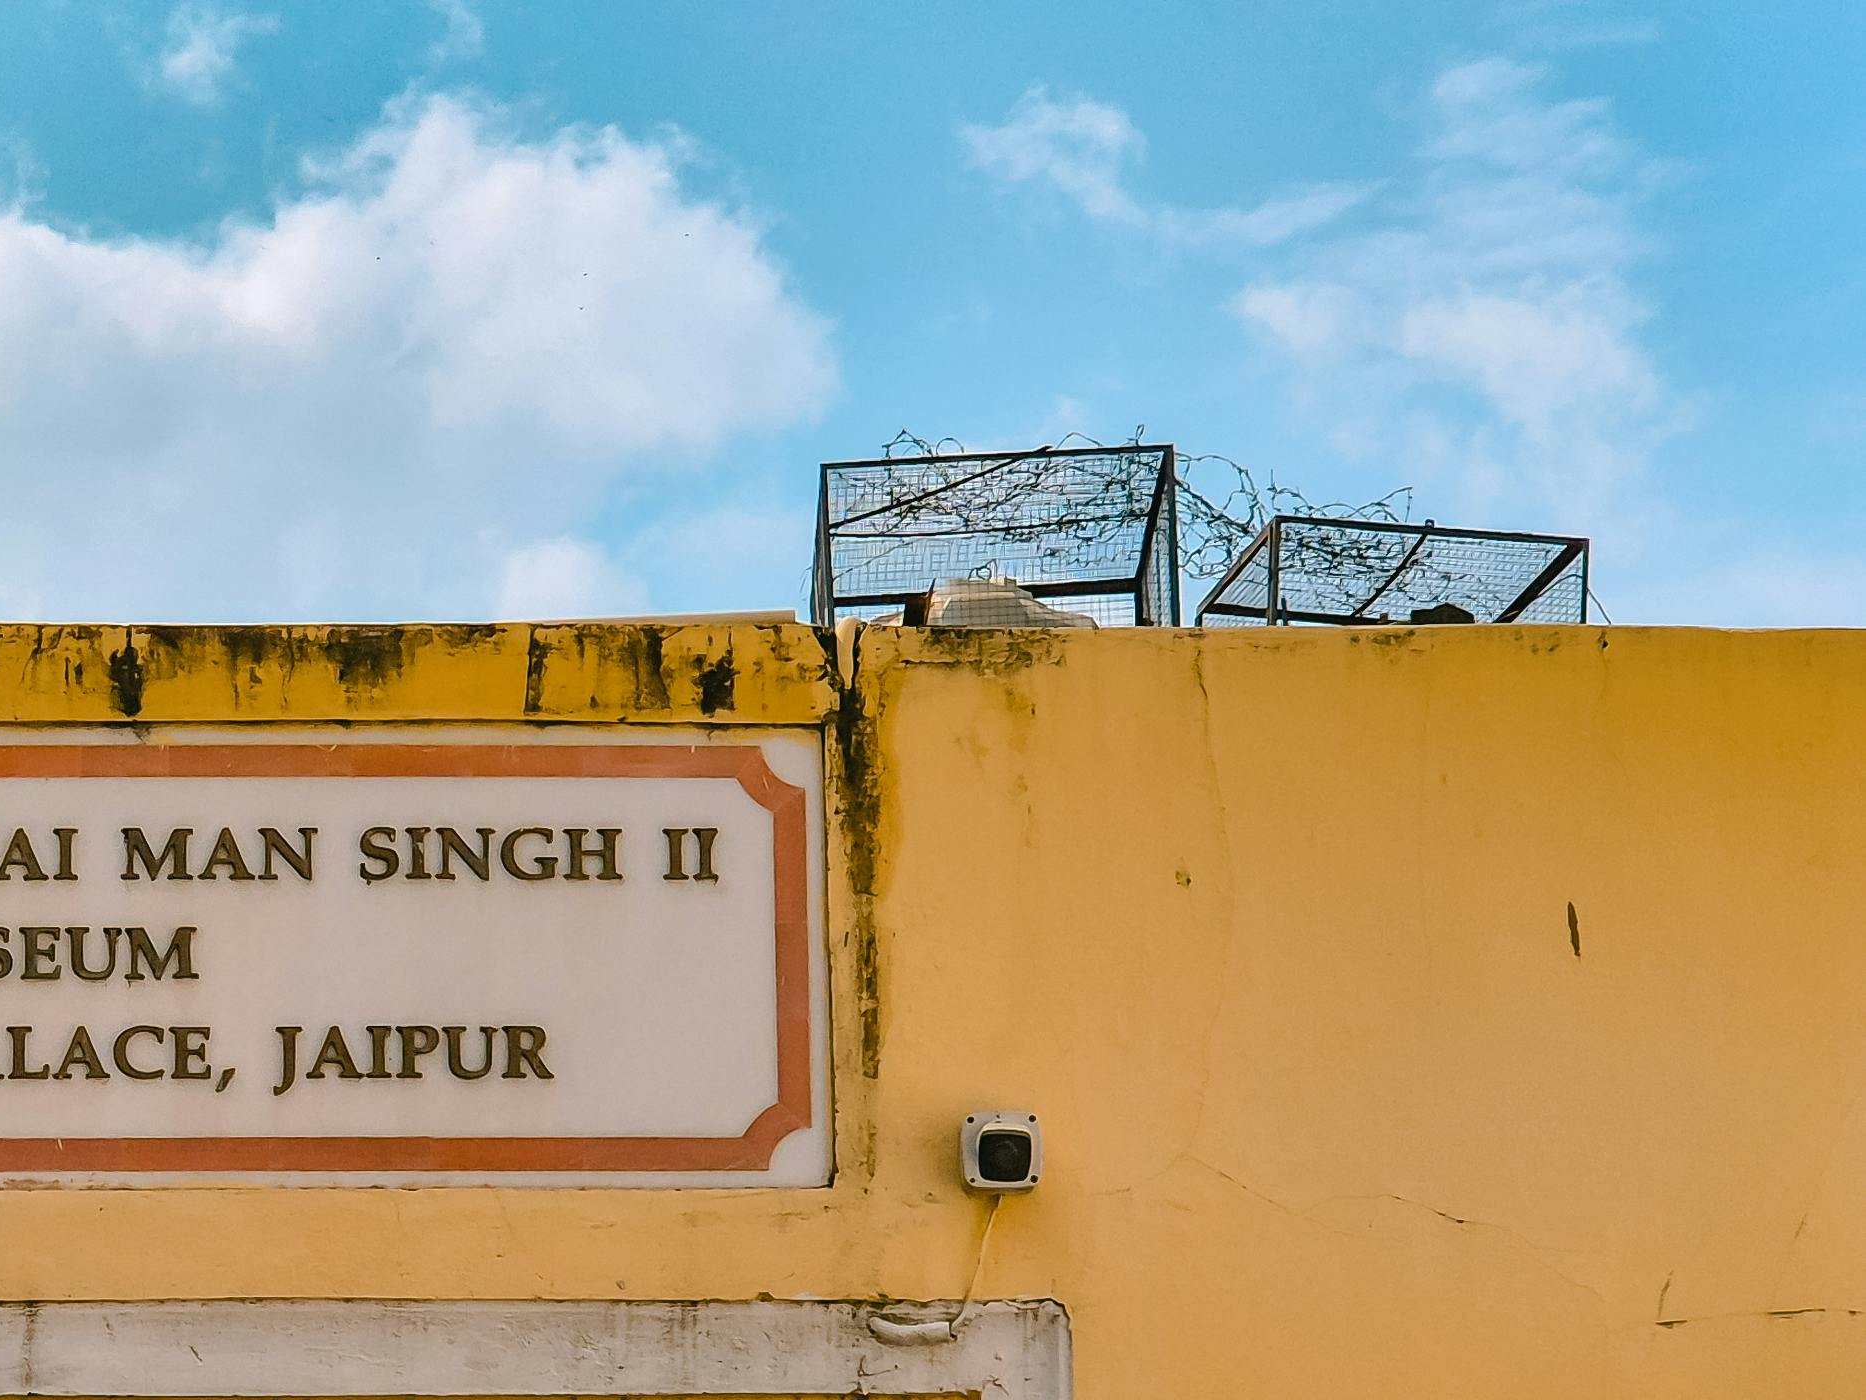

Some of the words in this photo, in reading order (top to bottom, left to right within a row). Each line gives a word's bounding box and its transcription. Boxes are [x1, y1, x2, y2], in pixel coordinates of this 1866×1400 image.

[120, 826, 319, 882] MAN
[359, 825, 624, 886] SINGH
[661, 826, 721, 885] II
[272, 1024, 555, 1097] JAIPUR
